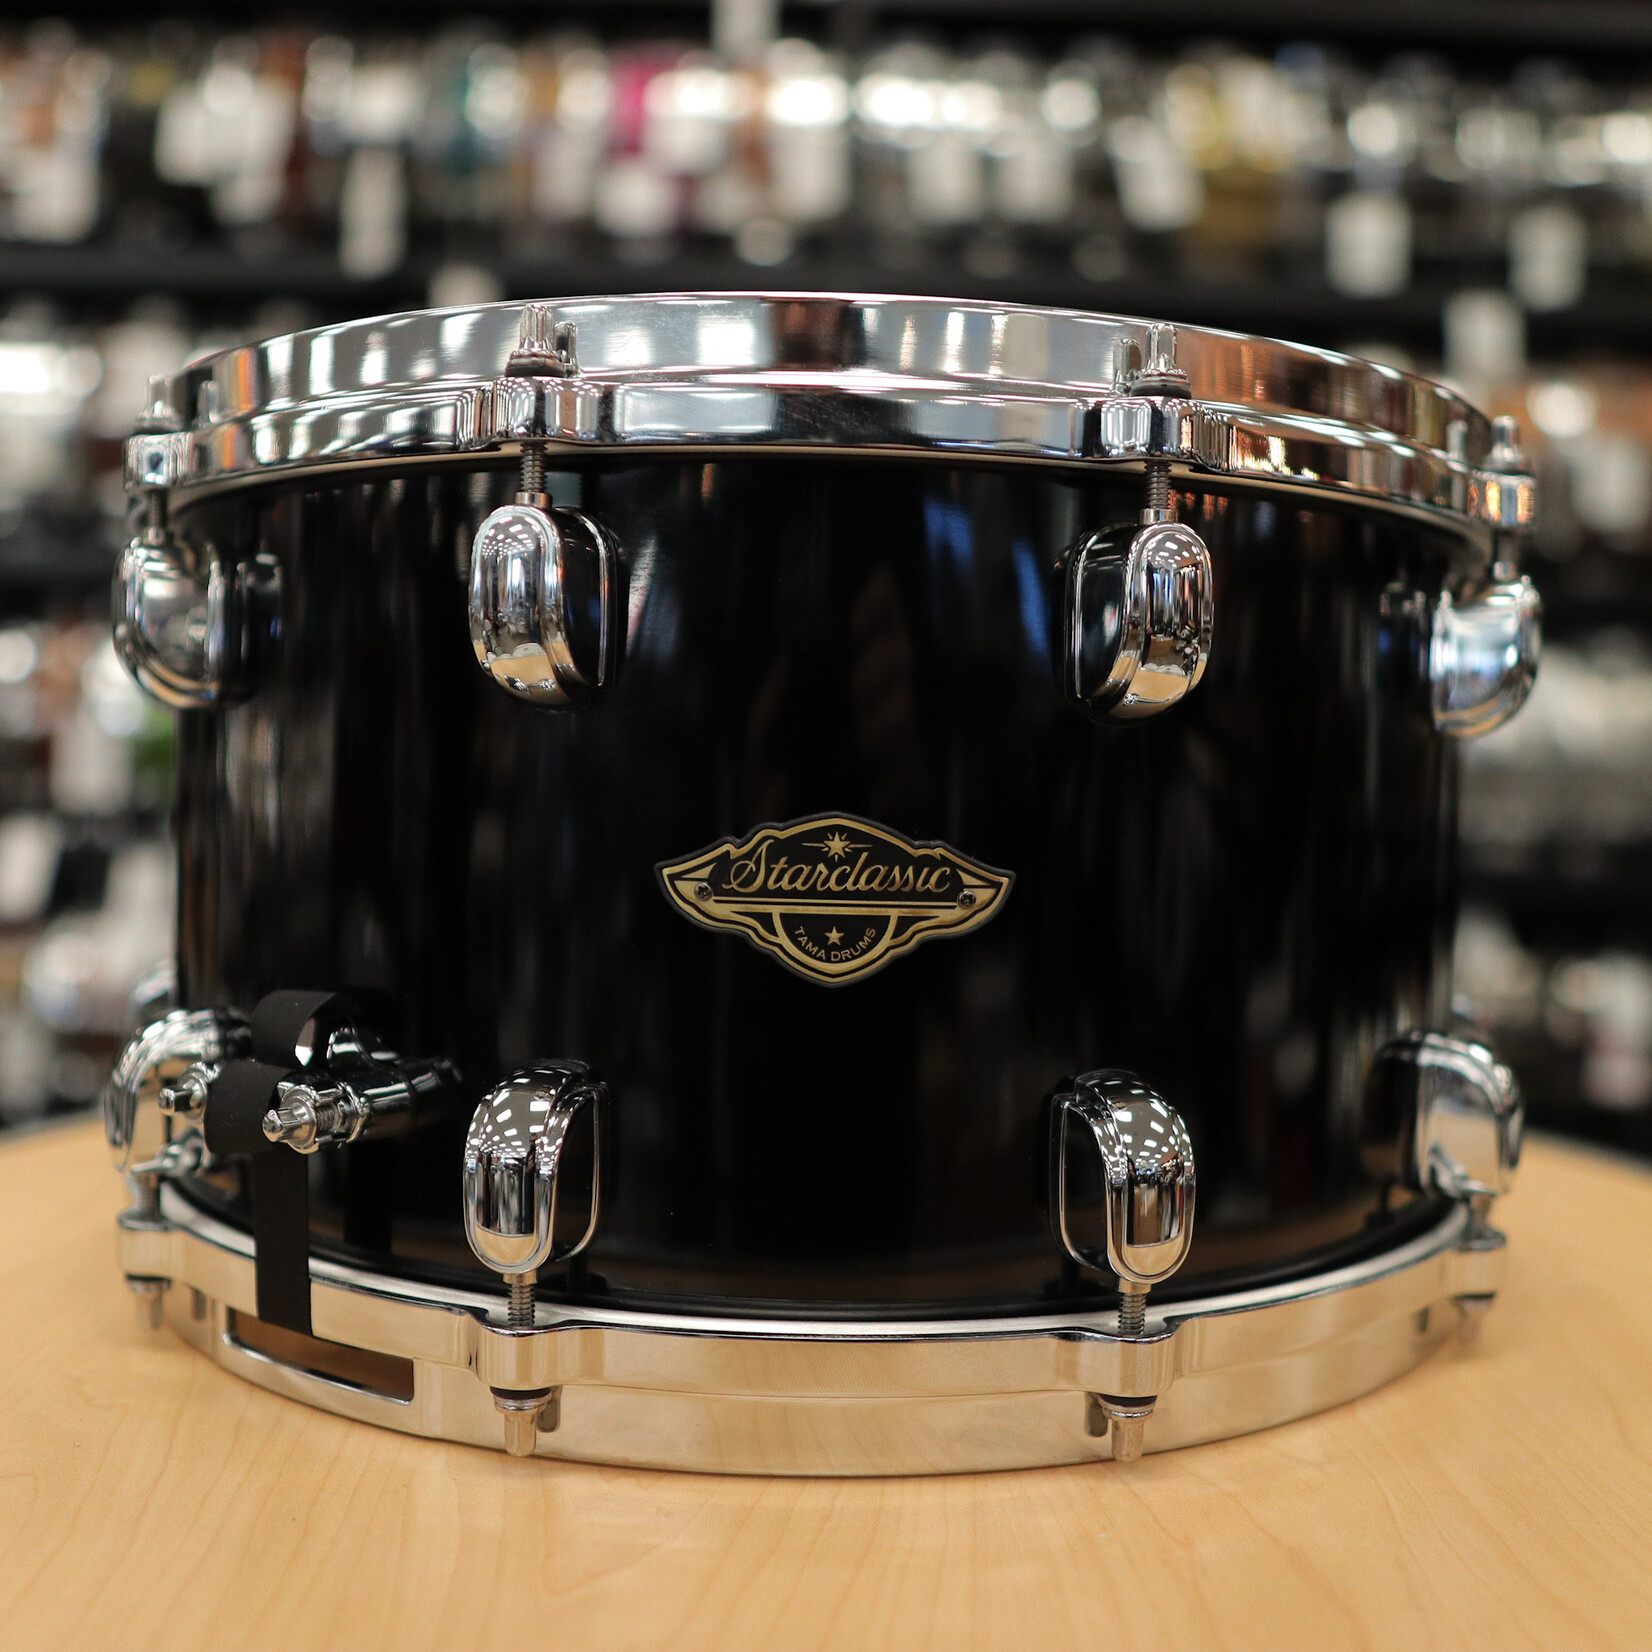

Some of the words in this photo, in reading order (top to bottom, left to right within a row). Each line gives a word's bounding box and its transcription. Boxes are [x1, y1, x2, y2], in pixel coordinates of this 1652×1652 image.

[722, 839, 952, 893] Starclassic
[794, 925, 826, 960] TAMA
[830, 927, 876, 961] DRUMS
